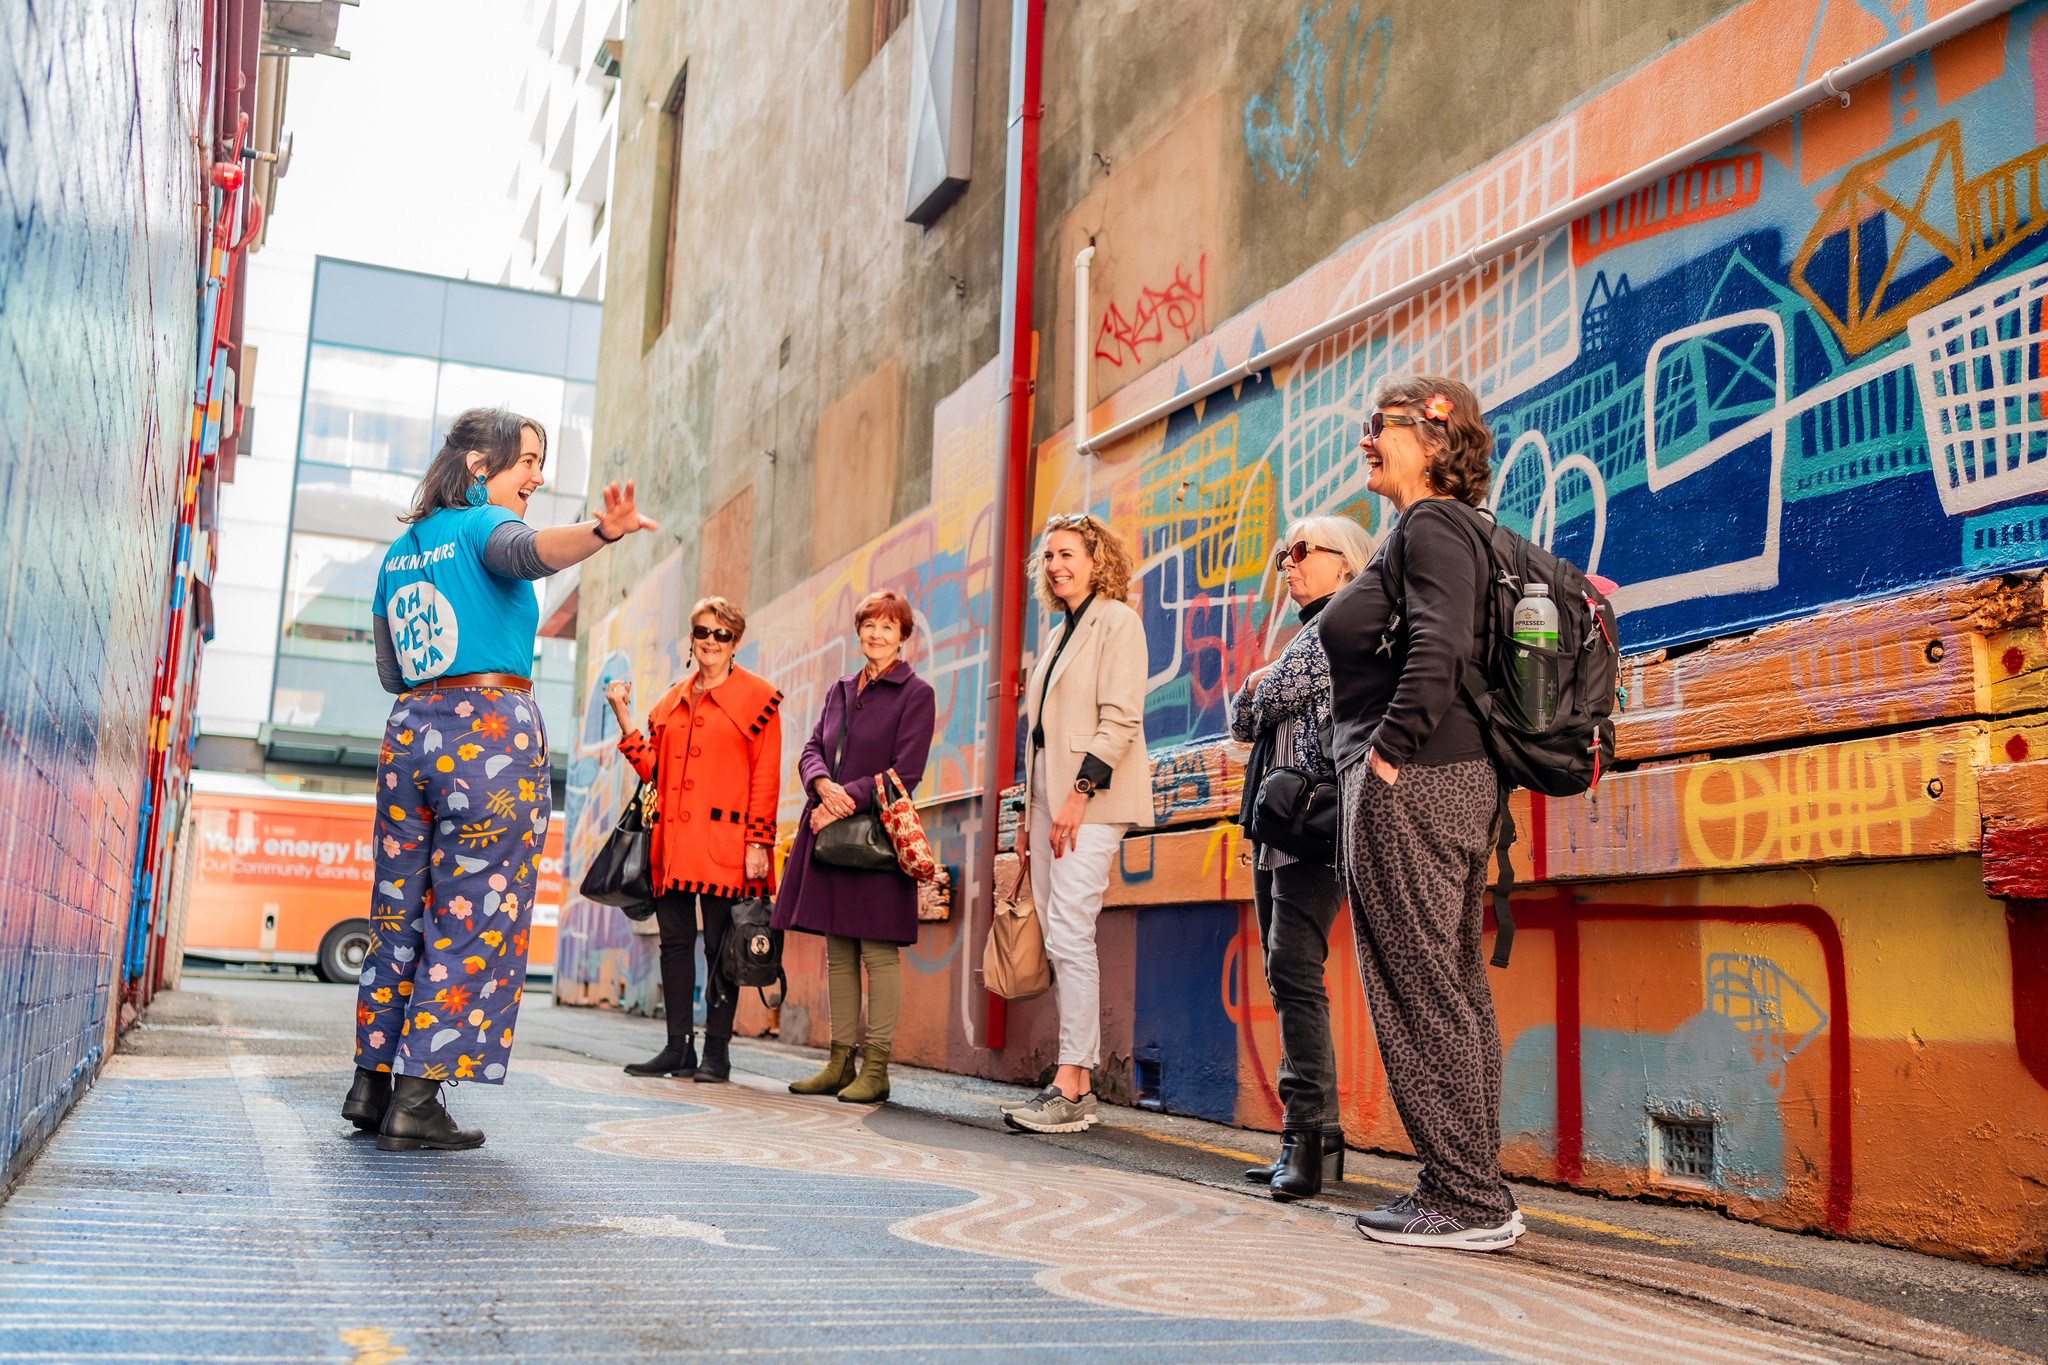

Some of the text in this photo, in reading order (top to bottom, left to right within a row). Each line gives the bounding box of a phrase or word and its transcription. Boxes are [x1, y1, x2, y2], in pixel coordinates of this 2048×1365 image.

[385, 554, 423, 574] ALKIN
[396, 587, 421, 619] OH
[396, 604, 443, 655] HEY!
[412, 645, 443, 676] WA
[205, 830, 260, 855] Your
[263, 837, 351, 864] energy
[354, 839, 373, 862] is
[201, 857, 228, 873] Our
[231, 858, 313, 880] Community
[315, 864, 360, 881] Grants
